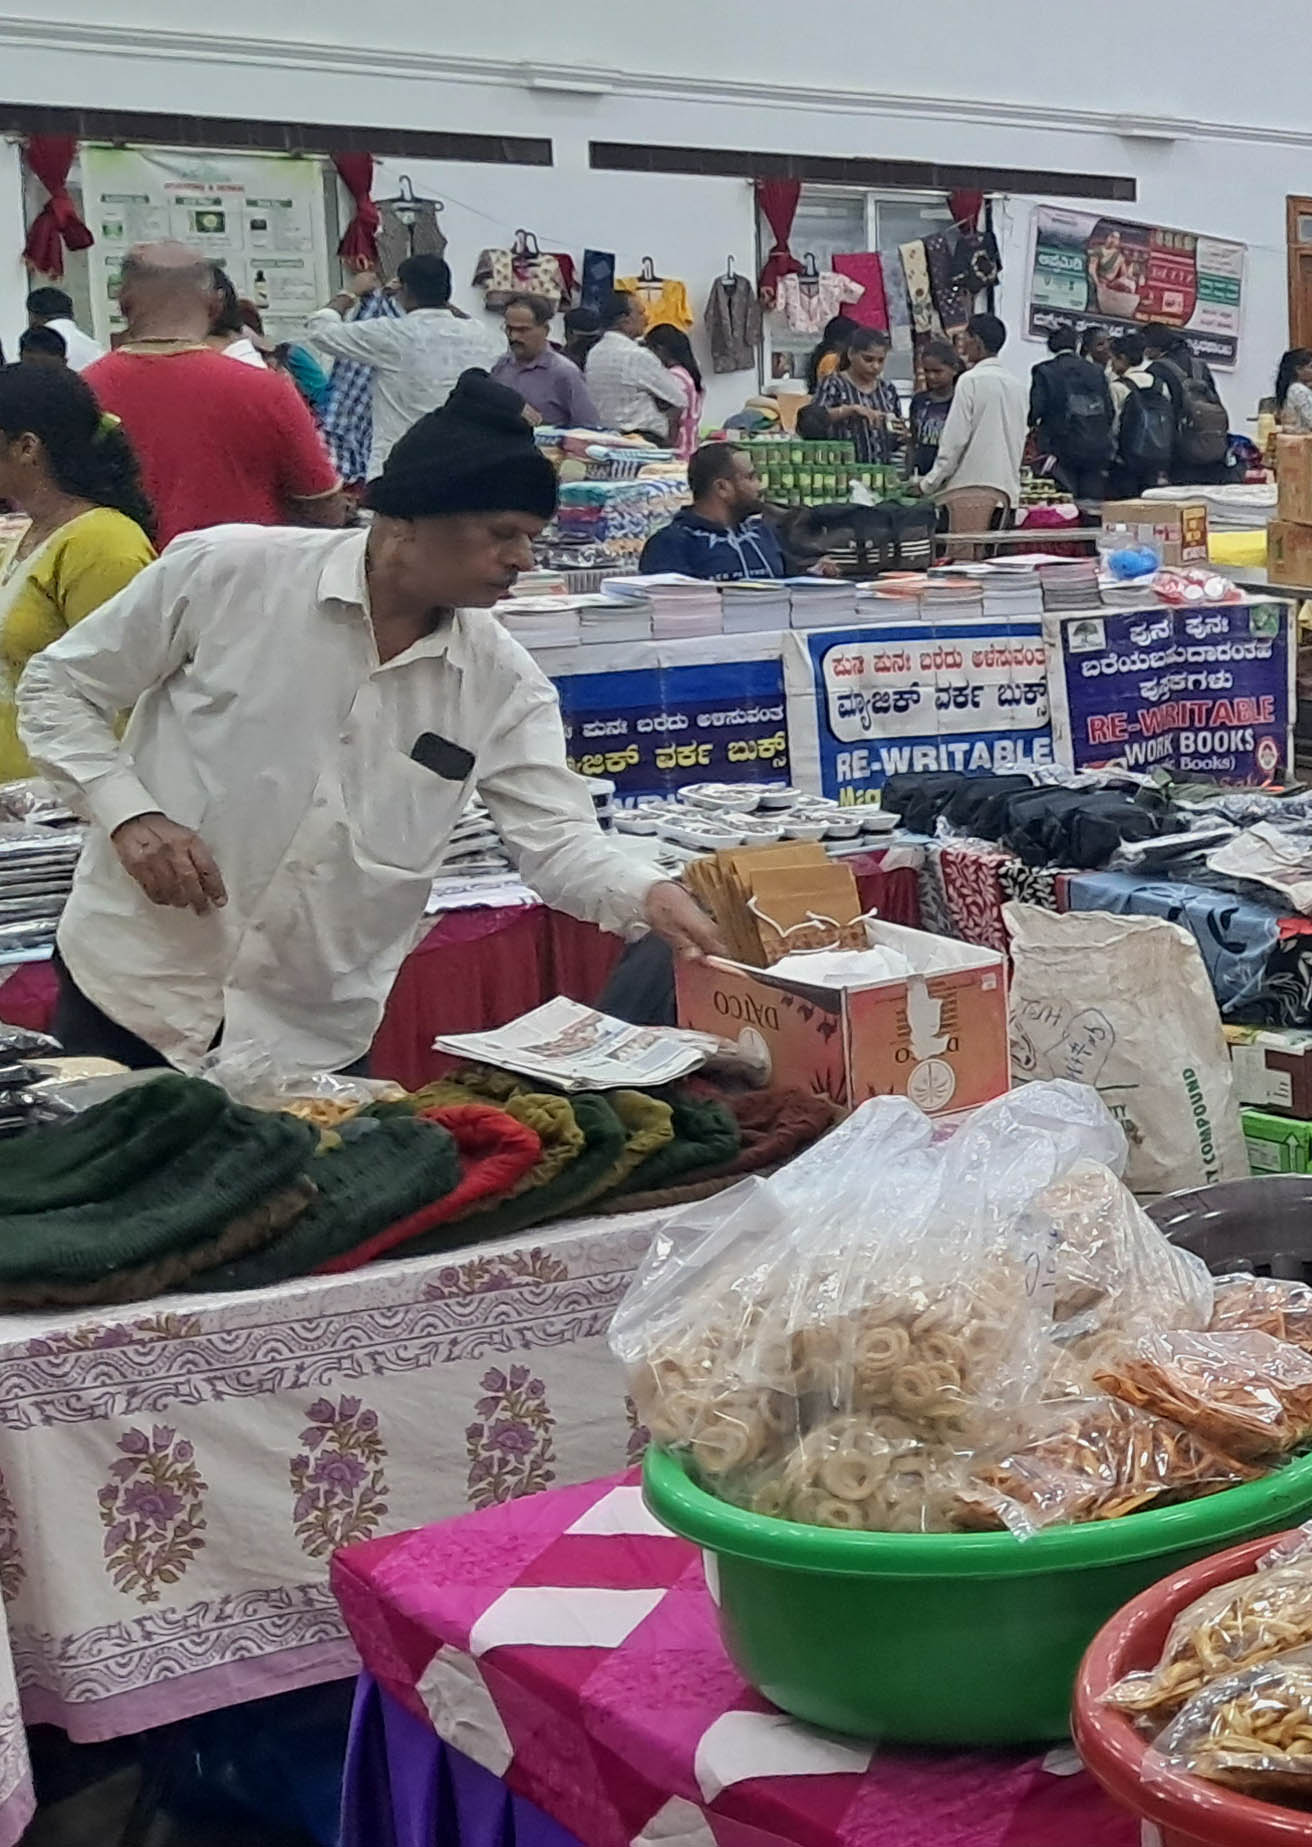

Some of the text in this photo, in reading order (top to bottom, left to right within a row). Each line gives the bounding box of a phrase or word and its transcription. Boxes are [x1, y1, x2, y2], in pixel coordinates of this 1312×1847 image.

[1185, 615, 1229, 639] ಪುನಃ
[874, 649, 911, 675] ಪುನಃ
[920, 646, 963, 671] ಬರೆದು
[637, 713, 689, 732] ಬರೆದು
[1087, 696, 1275, 744] RE-WRITABLE
[836, 737, 1052, 783] RE-WRITABLE
[1124, 729, 1255, 767] WORK BOOKS
[1180, 754, 1236, 771] Books)
[714, 989, 780, 1030] DATCO
[1182, 1067, 1216, 1165] COMPOUND
